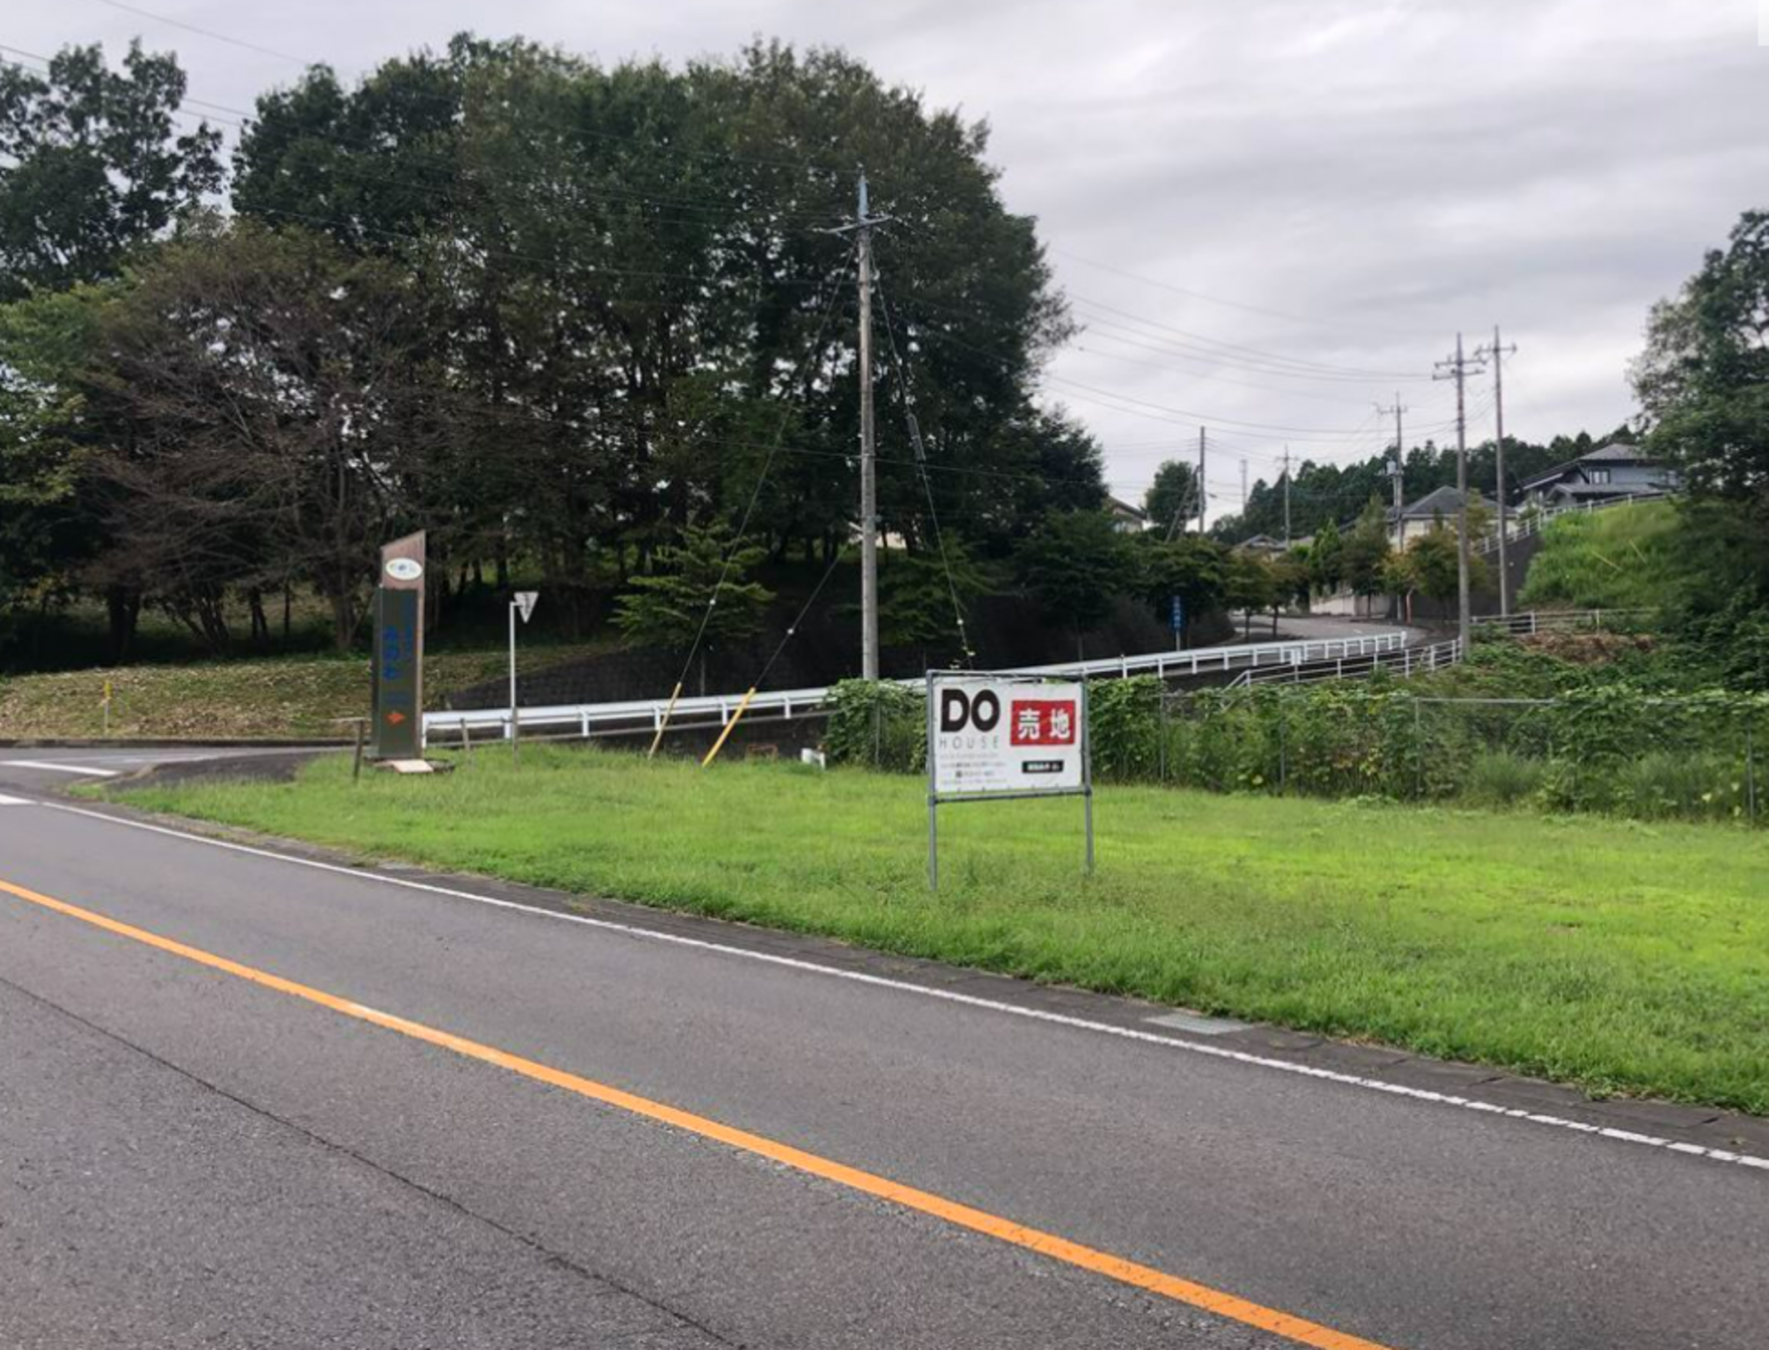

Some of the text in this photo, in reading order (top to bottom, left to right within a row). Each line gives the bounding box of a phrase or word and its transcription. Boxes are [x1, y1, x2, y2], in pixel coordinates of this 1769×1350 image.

[940, 688, 1000, 732] DO
[1018, 708, 1070, 740] 売地
[939, 736, 999, 749] HOUSE
